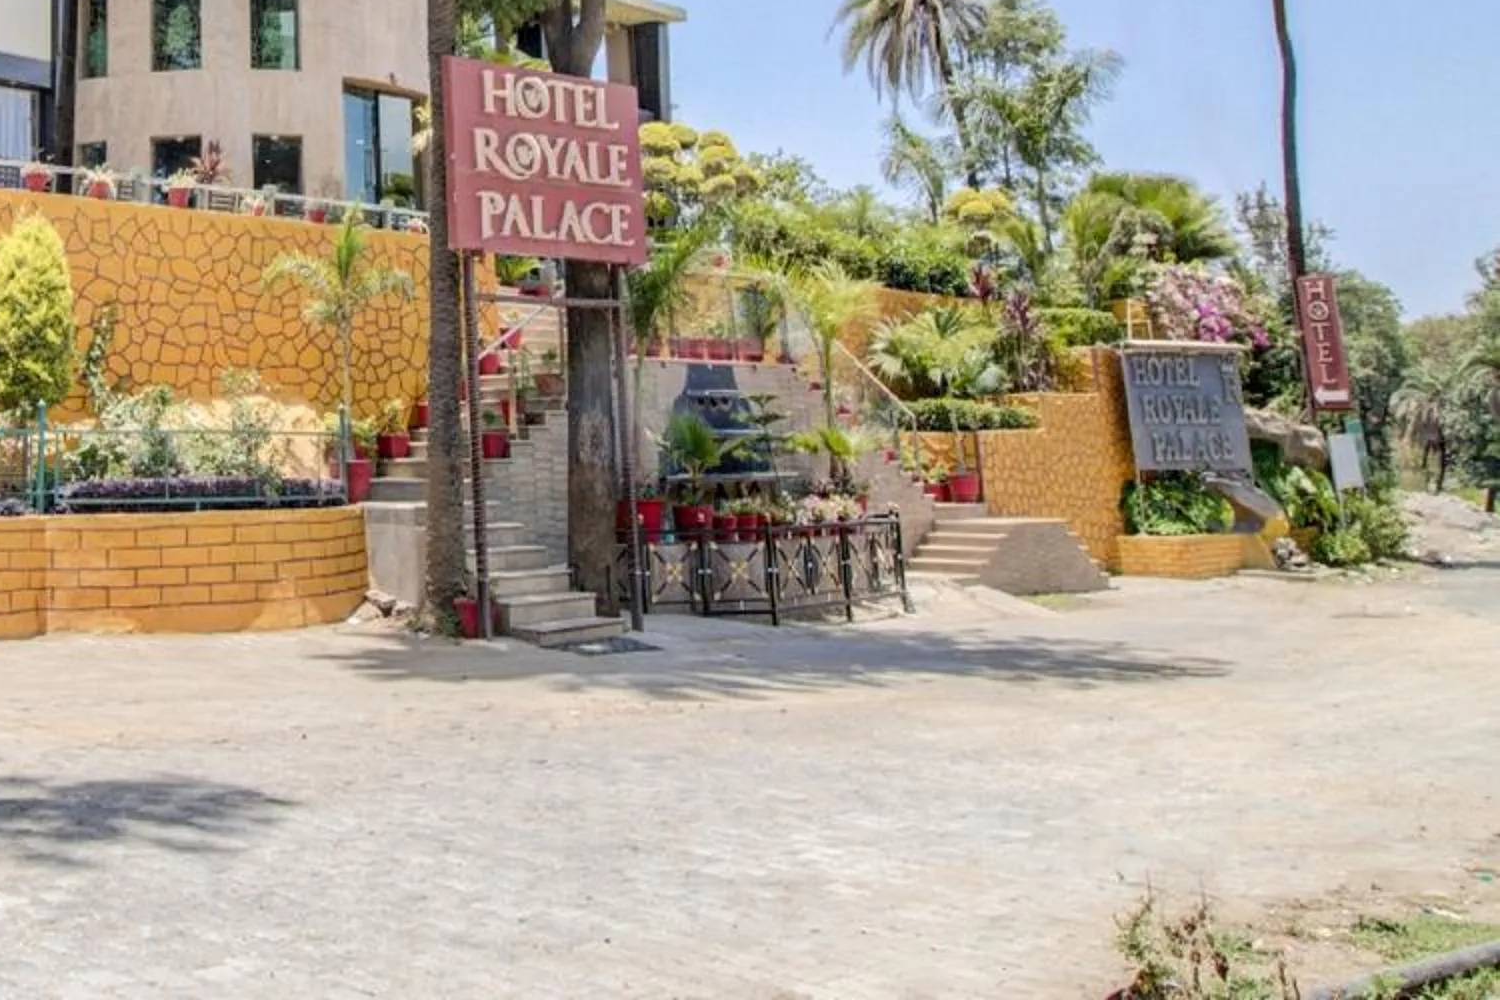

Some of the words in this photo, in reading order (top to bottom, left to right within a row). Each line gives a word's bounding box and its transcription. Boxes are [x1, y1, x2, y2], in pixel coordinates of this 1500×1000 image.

[482, 69, 619, 130] HOTEL
[473, 127, 632, 186] ROYALE
[477, 190, 635, 246] PALACE
[1304, 280, 1336, 383] HOTEL
[1133, 356, 1200, 387] HOTEL
[1143, 394, 1221, 424] ROYALE
[1153, 431, 1235, 462] PALACE
